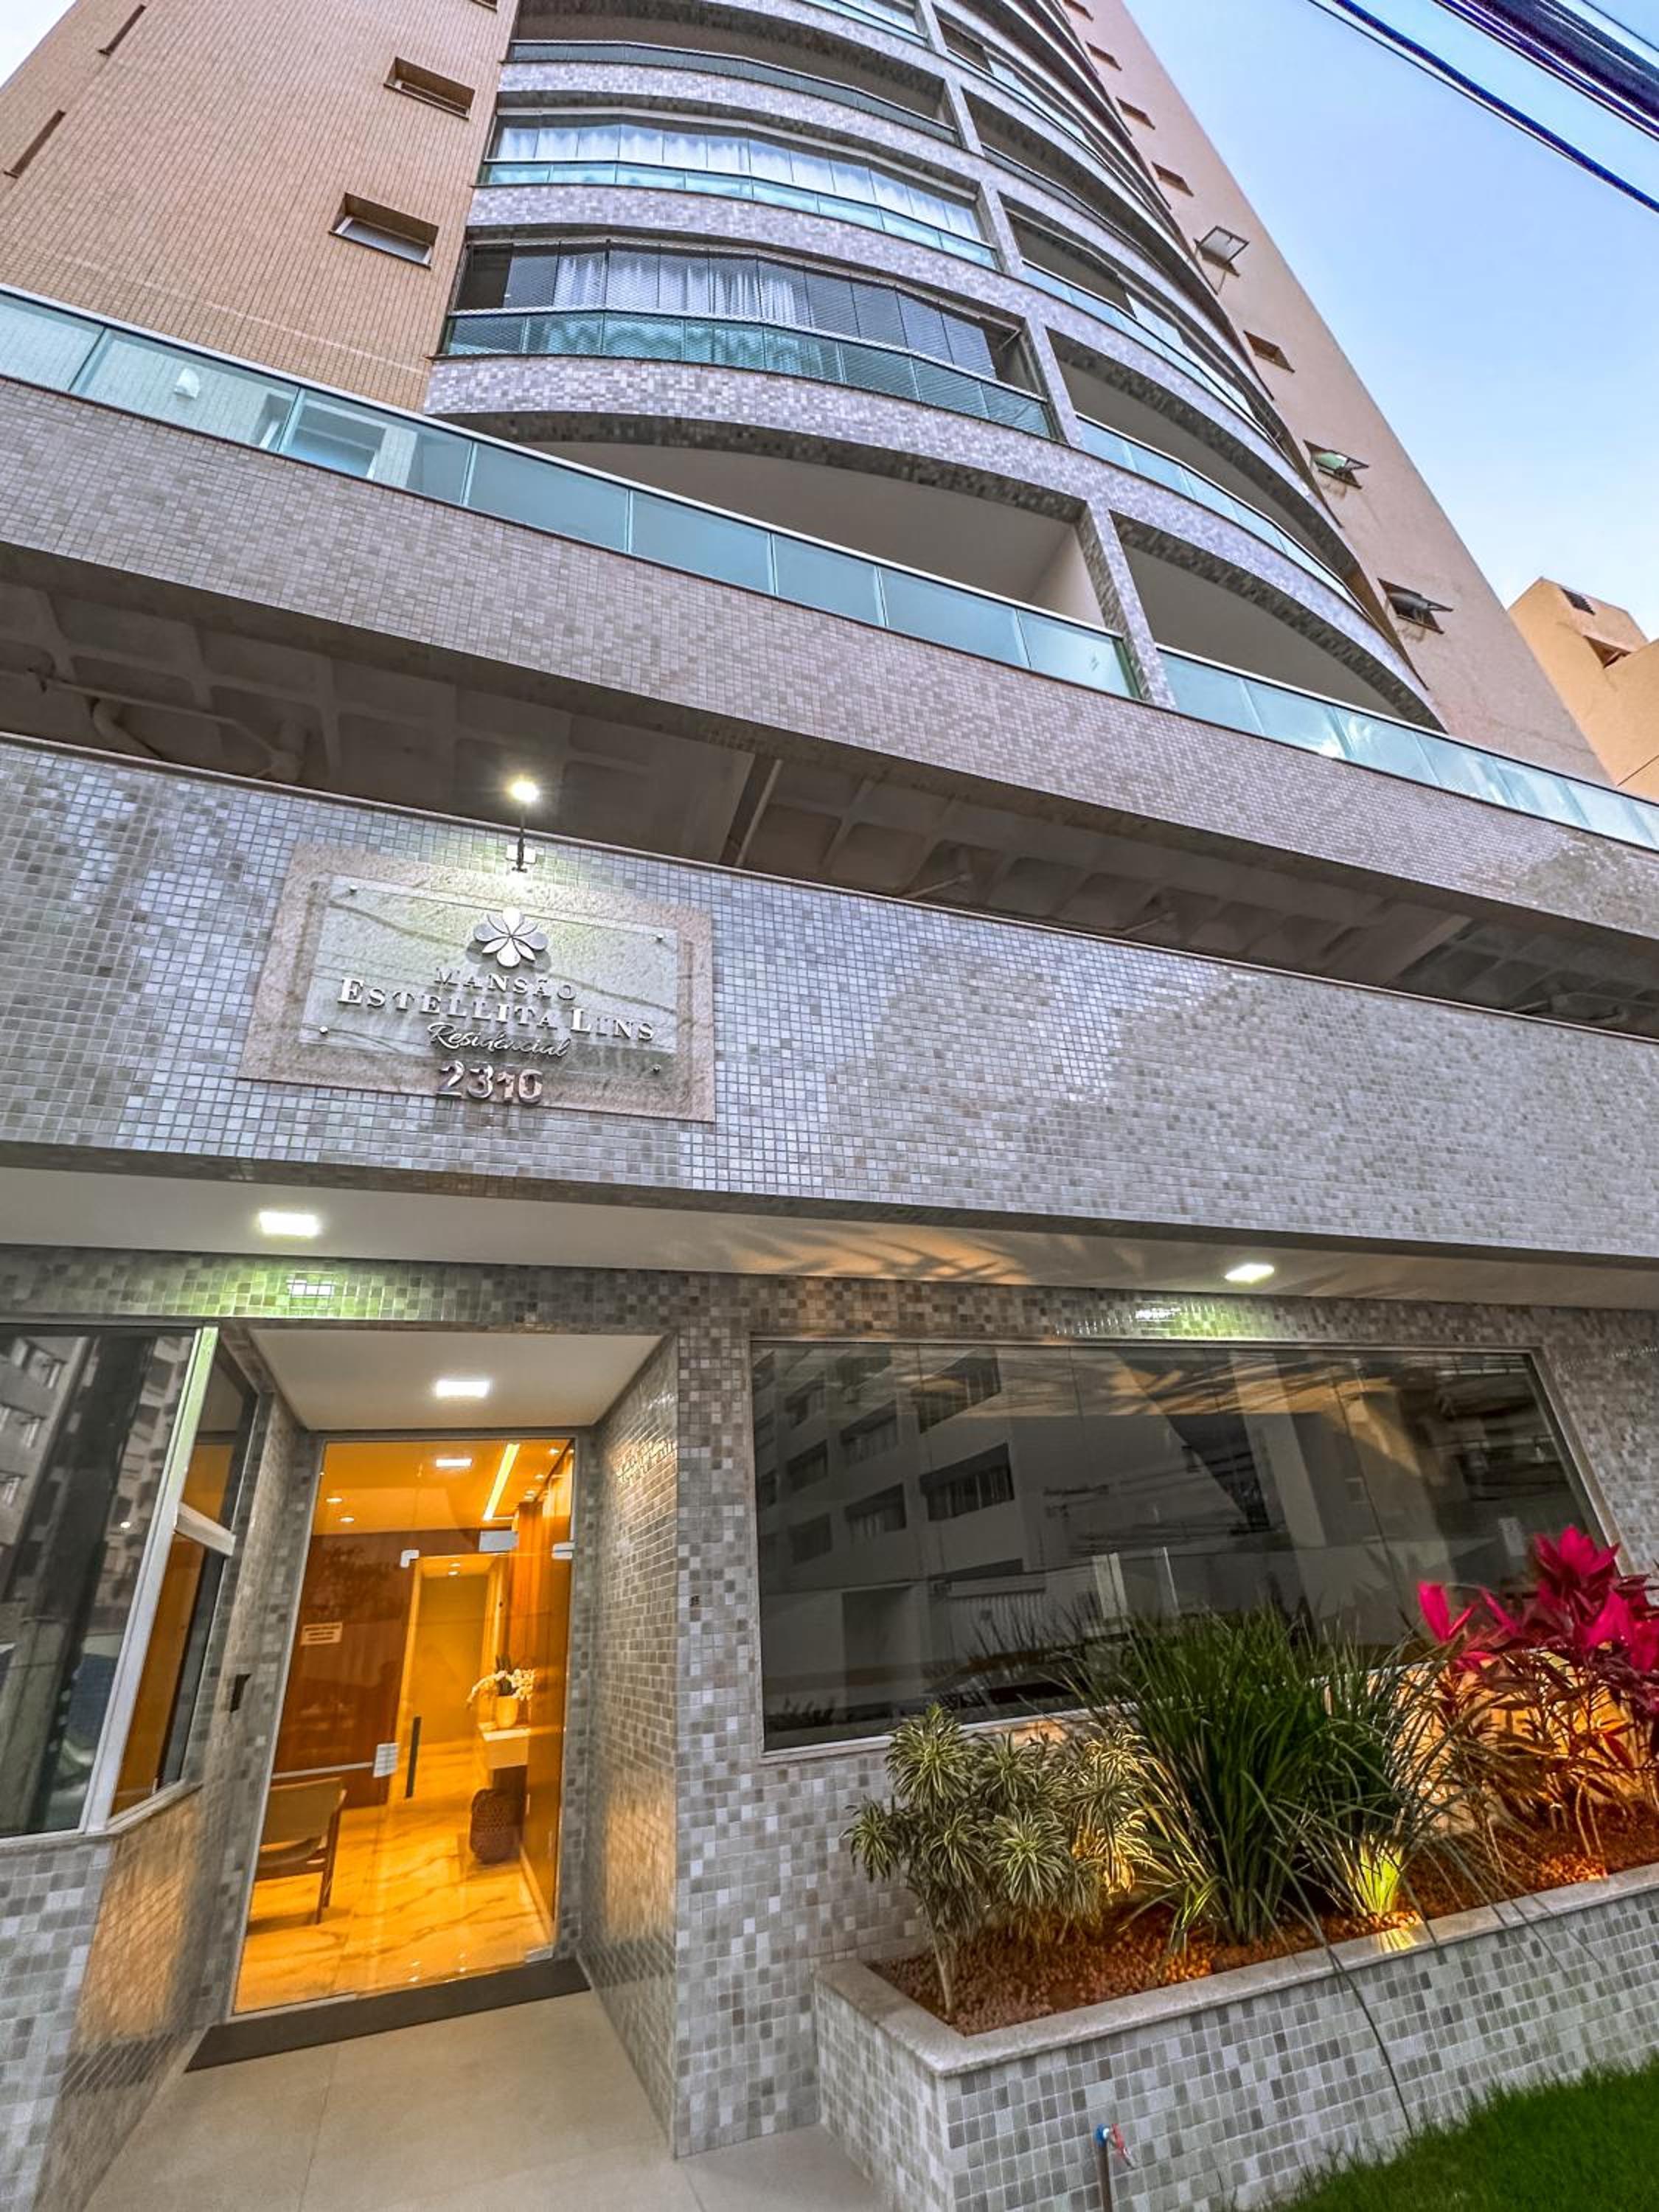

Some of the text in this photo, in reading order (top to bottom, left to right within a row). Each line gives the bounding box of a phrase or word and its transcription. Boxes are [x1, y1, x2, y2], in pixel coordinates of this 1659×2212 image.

[434, 967, 576, 1000] MANSÃO
[337, 977, 654, 1041] ESTELLITA LINS
[428, 1022, 571, 1057] Residencial
